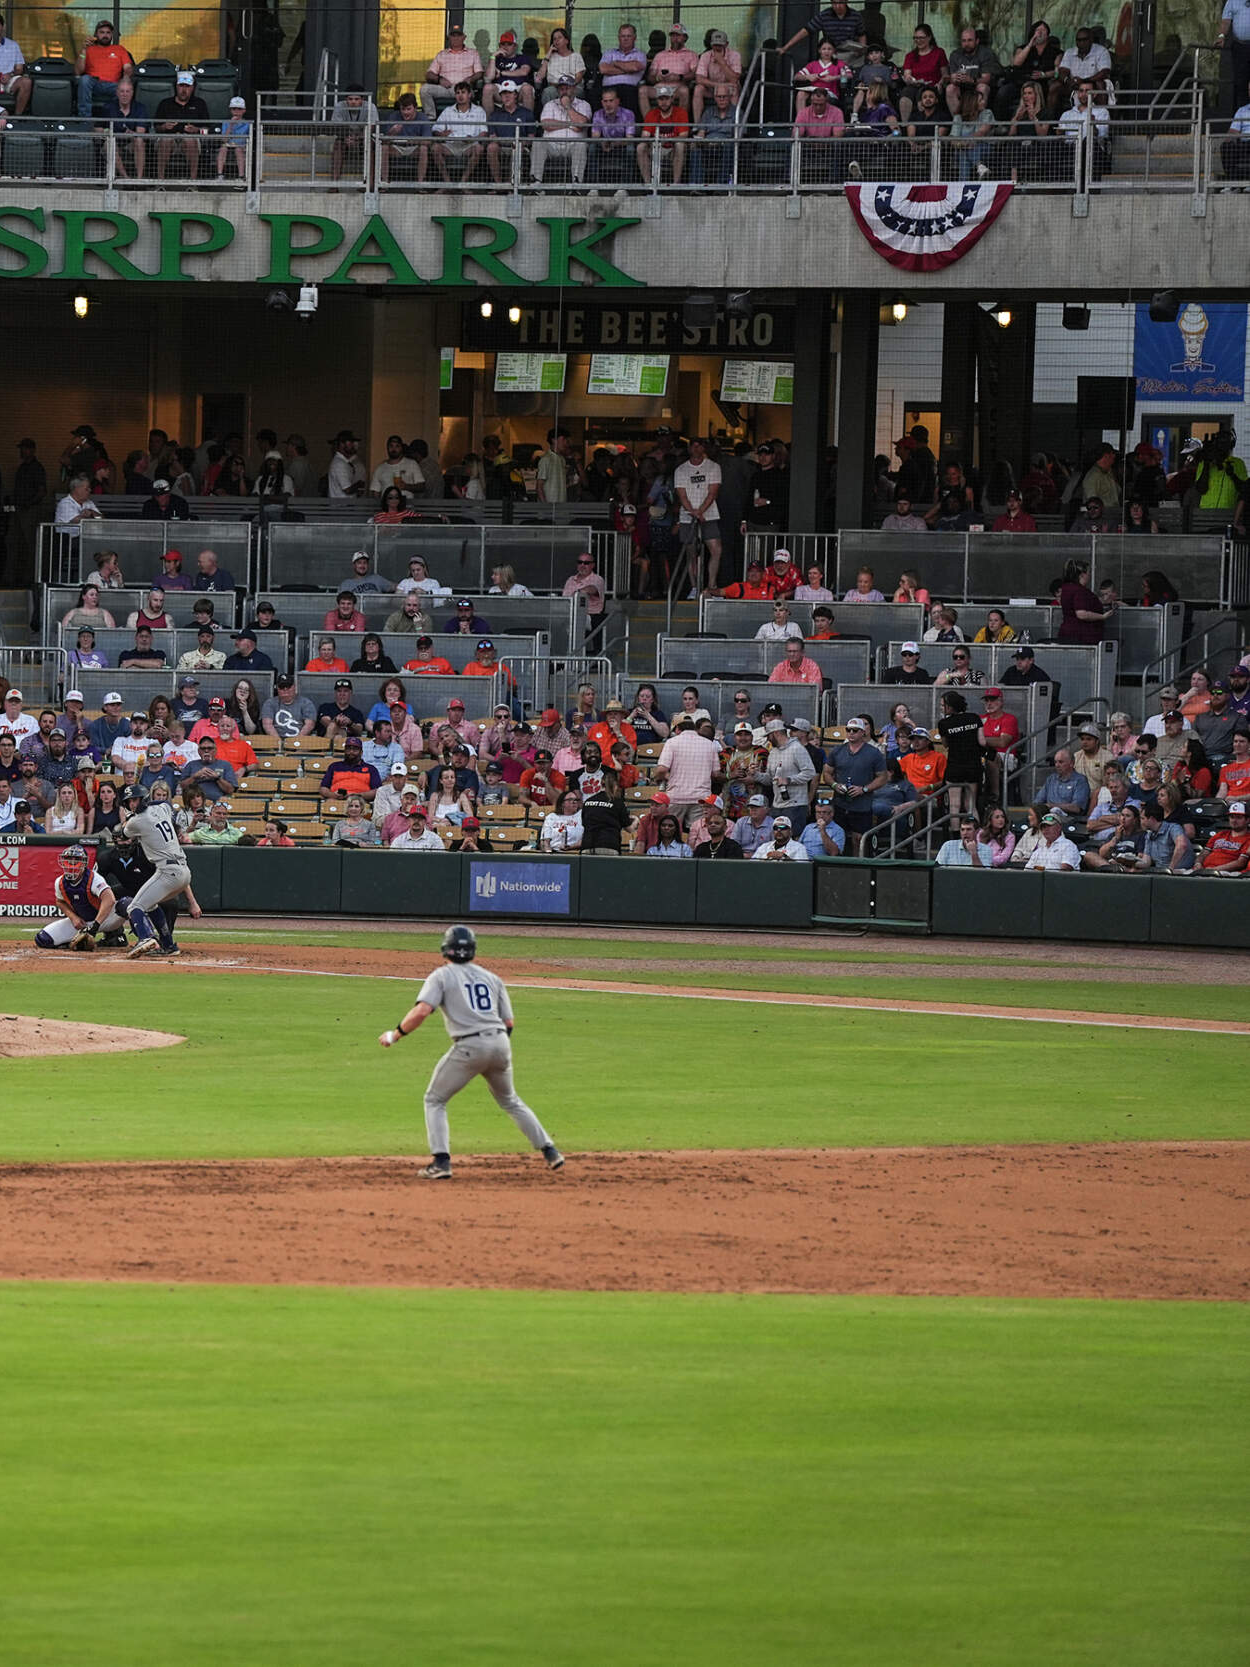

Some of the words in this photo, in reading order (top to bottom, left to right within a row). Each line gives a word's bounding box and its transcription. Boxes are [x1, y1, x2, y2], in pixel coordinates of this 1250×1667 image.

[256, 213, 647, 287] PARK
[518, 309, 586, 345] THE
[948, 725, 964, 734] EVENT
[155, 820, 174, 843] 19
[500, 881, 562, 892] Nationwide
[464, 983, 492, 1011] 18
